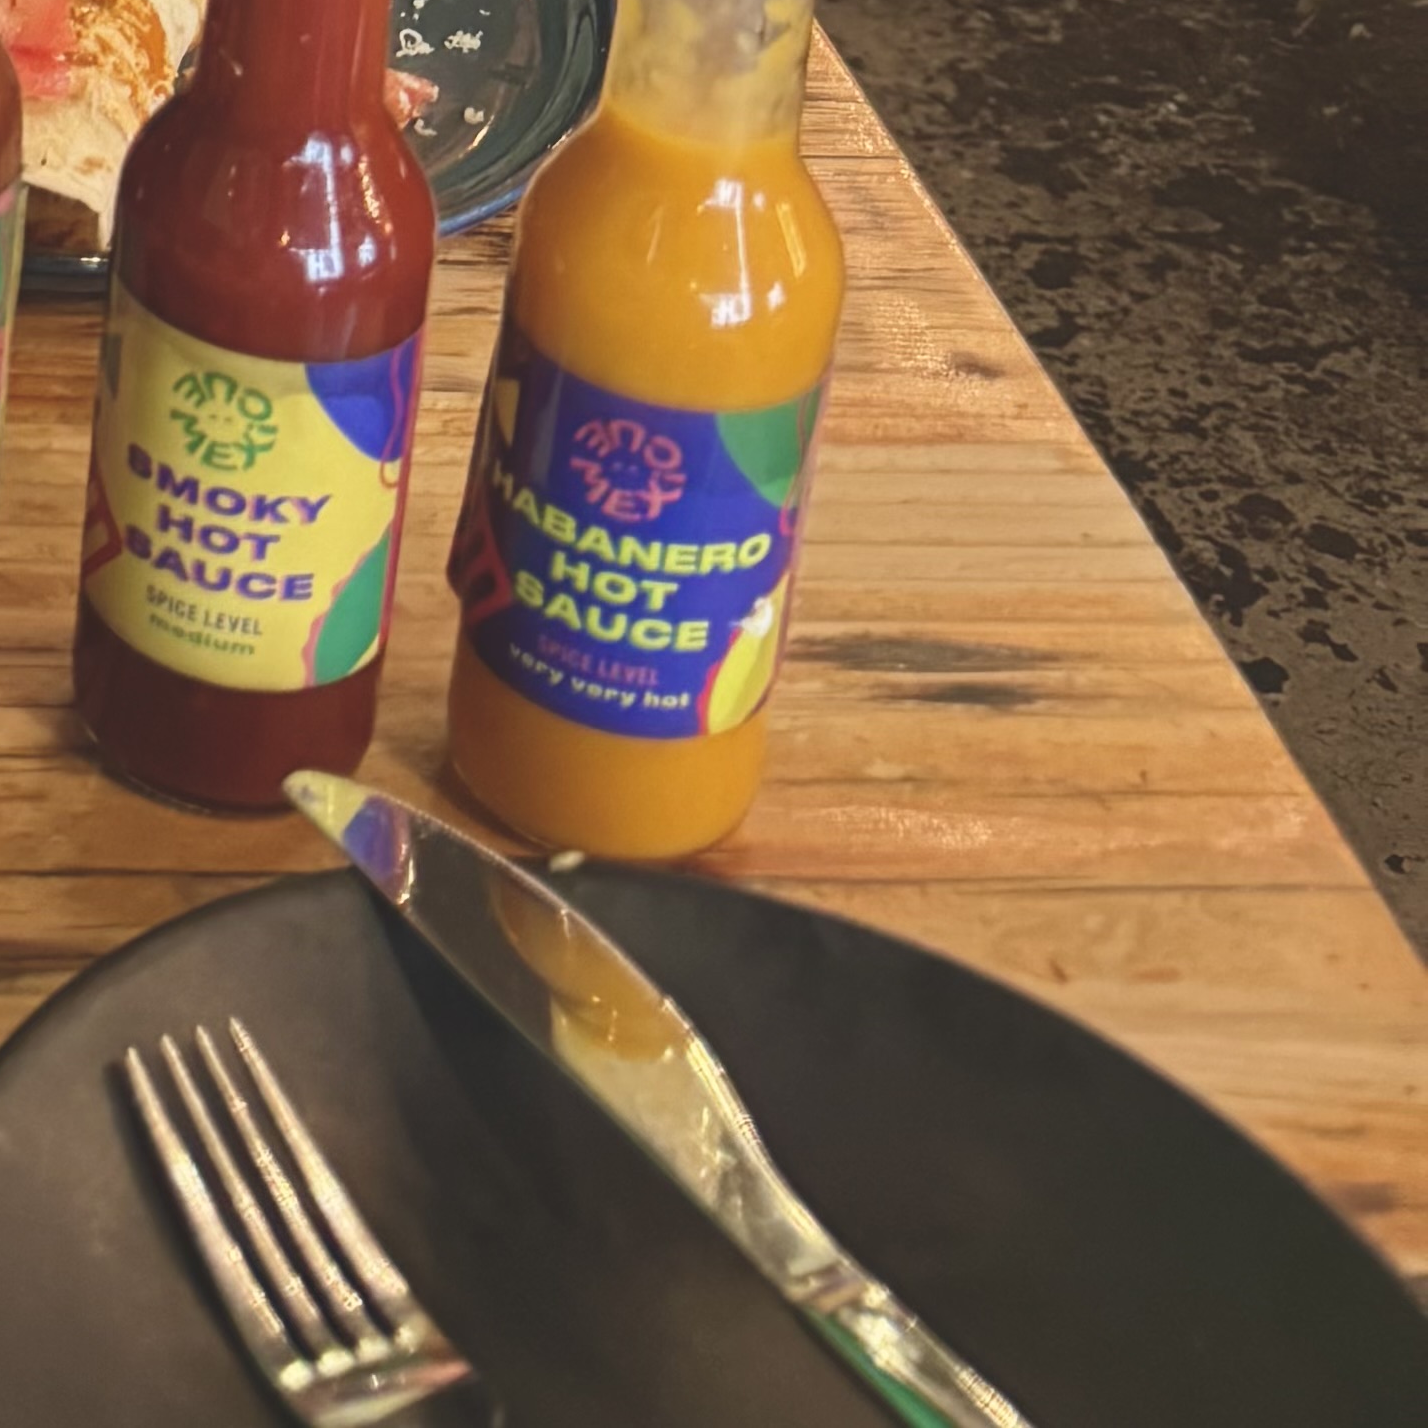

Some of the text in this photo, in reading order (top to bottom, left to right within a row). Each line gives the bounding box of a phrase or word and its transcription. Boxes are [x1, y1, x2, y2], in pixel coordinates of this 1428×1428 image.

[158, 503, 281, 562] HOT
[494, 460, 772, 575] HABANERO
[146, 583, 262, 636] SPICE LEVEL
[513, 569, 711, 652] SAUCE
[551, 550, 680, 612] HOT
[509, 643, 691, 709] very very hot
